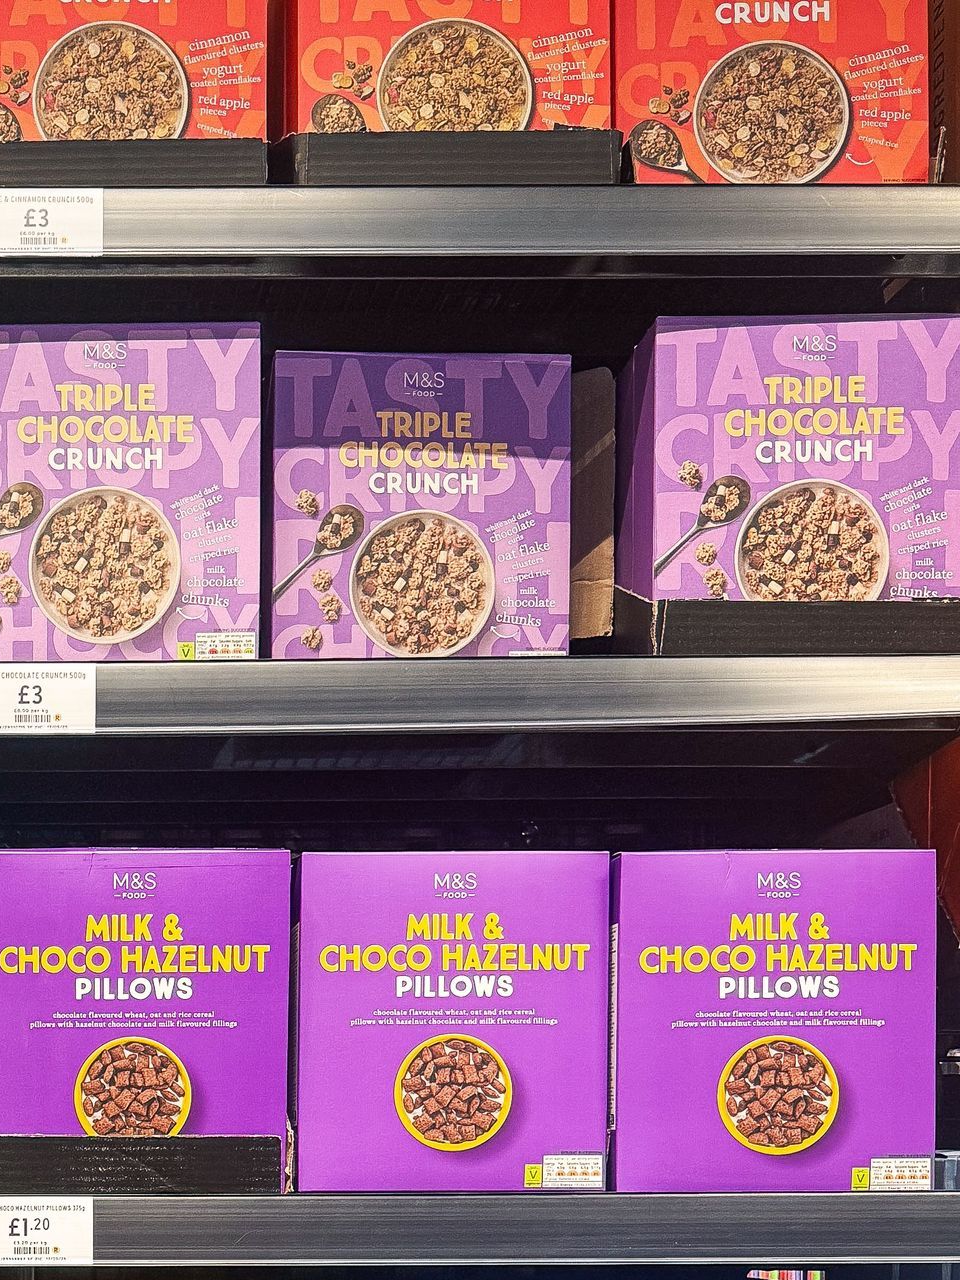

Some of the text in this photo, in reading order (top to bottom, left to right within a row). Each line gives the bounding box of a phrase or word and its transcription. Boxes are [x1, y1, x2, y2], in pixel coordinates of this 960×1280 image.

[715, 0, 831, 26] CRUNCH
[188, 30, 250, 52] cinnamon
[202, 63, 243, 79] yogurt
[198, 95, 250, 111] red apple
[76, 195, 94, 205] 500g
[24, 208, 49, 228] £3
[83, 342, 128, 361] M&S
[55, 382, 156, 412] TRIPLE
[763, 375, 866, 404] TRIPLE
[16, 415, 194, 443] CHOCOLATE
[723, 406, 906, 436] CHOCOLATE
[47, 447, 164, 471] CRUNCH
[754, 439, 874, 465] CRUNCH
[183, 517, 239, 541] oat flake
[186, 575, 245, 588] chocolate
[181, 592, 230, 608] chunks
[2, 672, 39, 680] CHOCOLATE
[41, 672, 68, 680] CRUNCH
[69, 672, 86, 681] 500g
[18, 685, 43, 704] £3
[112, 872, 157, 890] M&S
[85, 914, 183, 943] MILK &
[406, 913, 504, 941] MILK &
[729, 913, 829, 942] MILK &
[121, 945, 271, 974] HAZELNUT
[319, 943, 590, 974] CHOCO HAZELNUT
[639, 944, 918, 974] CHOCO HAZELNUT
[75, 977, 193, 1000] PILLOWS
[395, 975, 514, 998] PILLOWS
[718, 975, 840, 999] PILLOWS
[8, 1218, 50, 1237] £1.20
